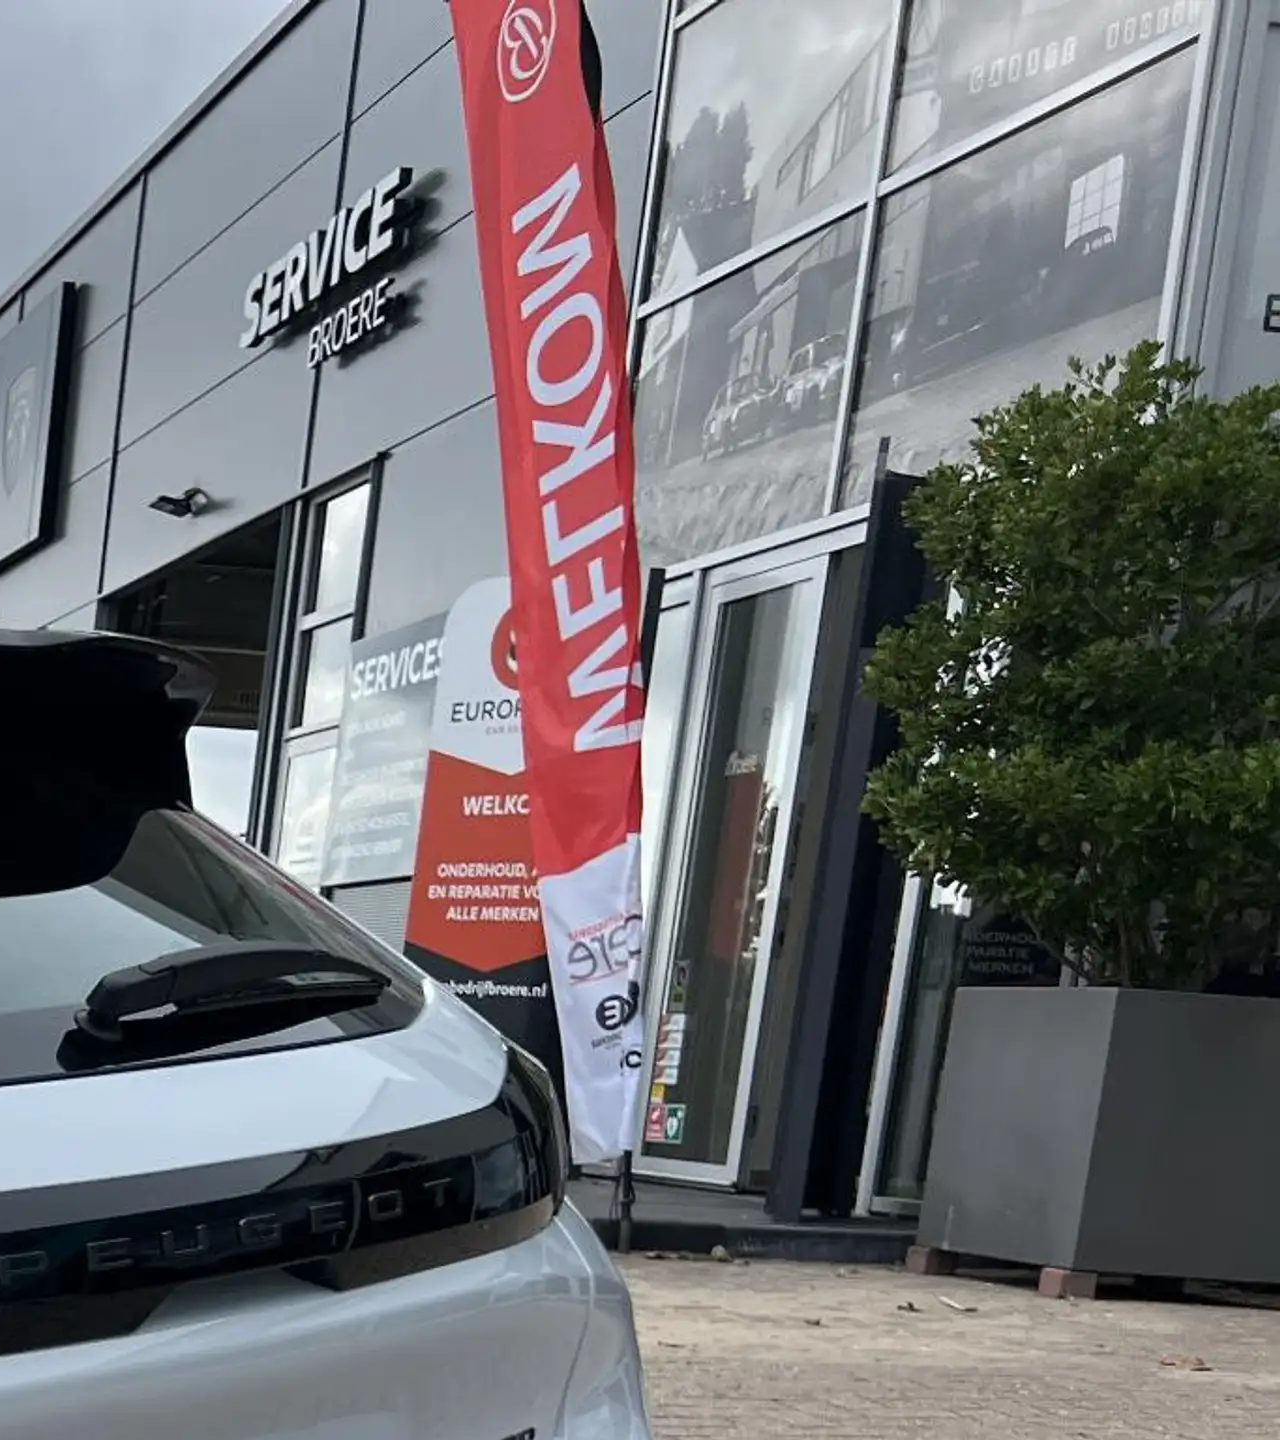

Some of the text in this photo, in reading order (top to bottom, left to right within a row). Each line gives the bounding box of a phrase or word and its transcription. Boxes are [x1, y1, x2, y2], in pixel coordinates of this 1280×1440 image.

[239, 166, 410, 348] SERVICE
[307, 277, 394, 369] BROERE
[437, 863, 528, 879] ONDERHOUD,
[428, 885, 446, 899] EN
[448, 885, 521, 899] REPARATIE
[446, 906, 539, 922] ALLE MERKEN
